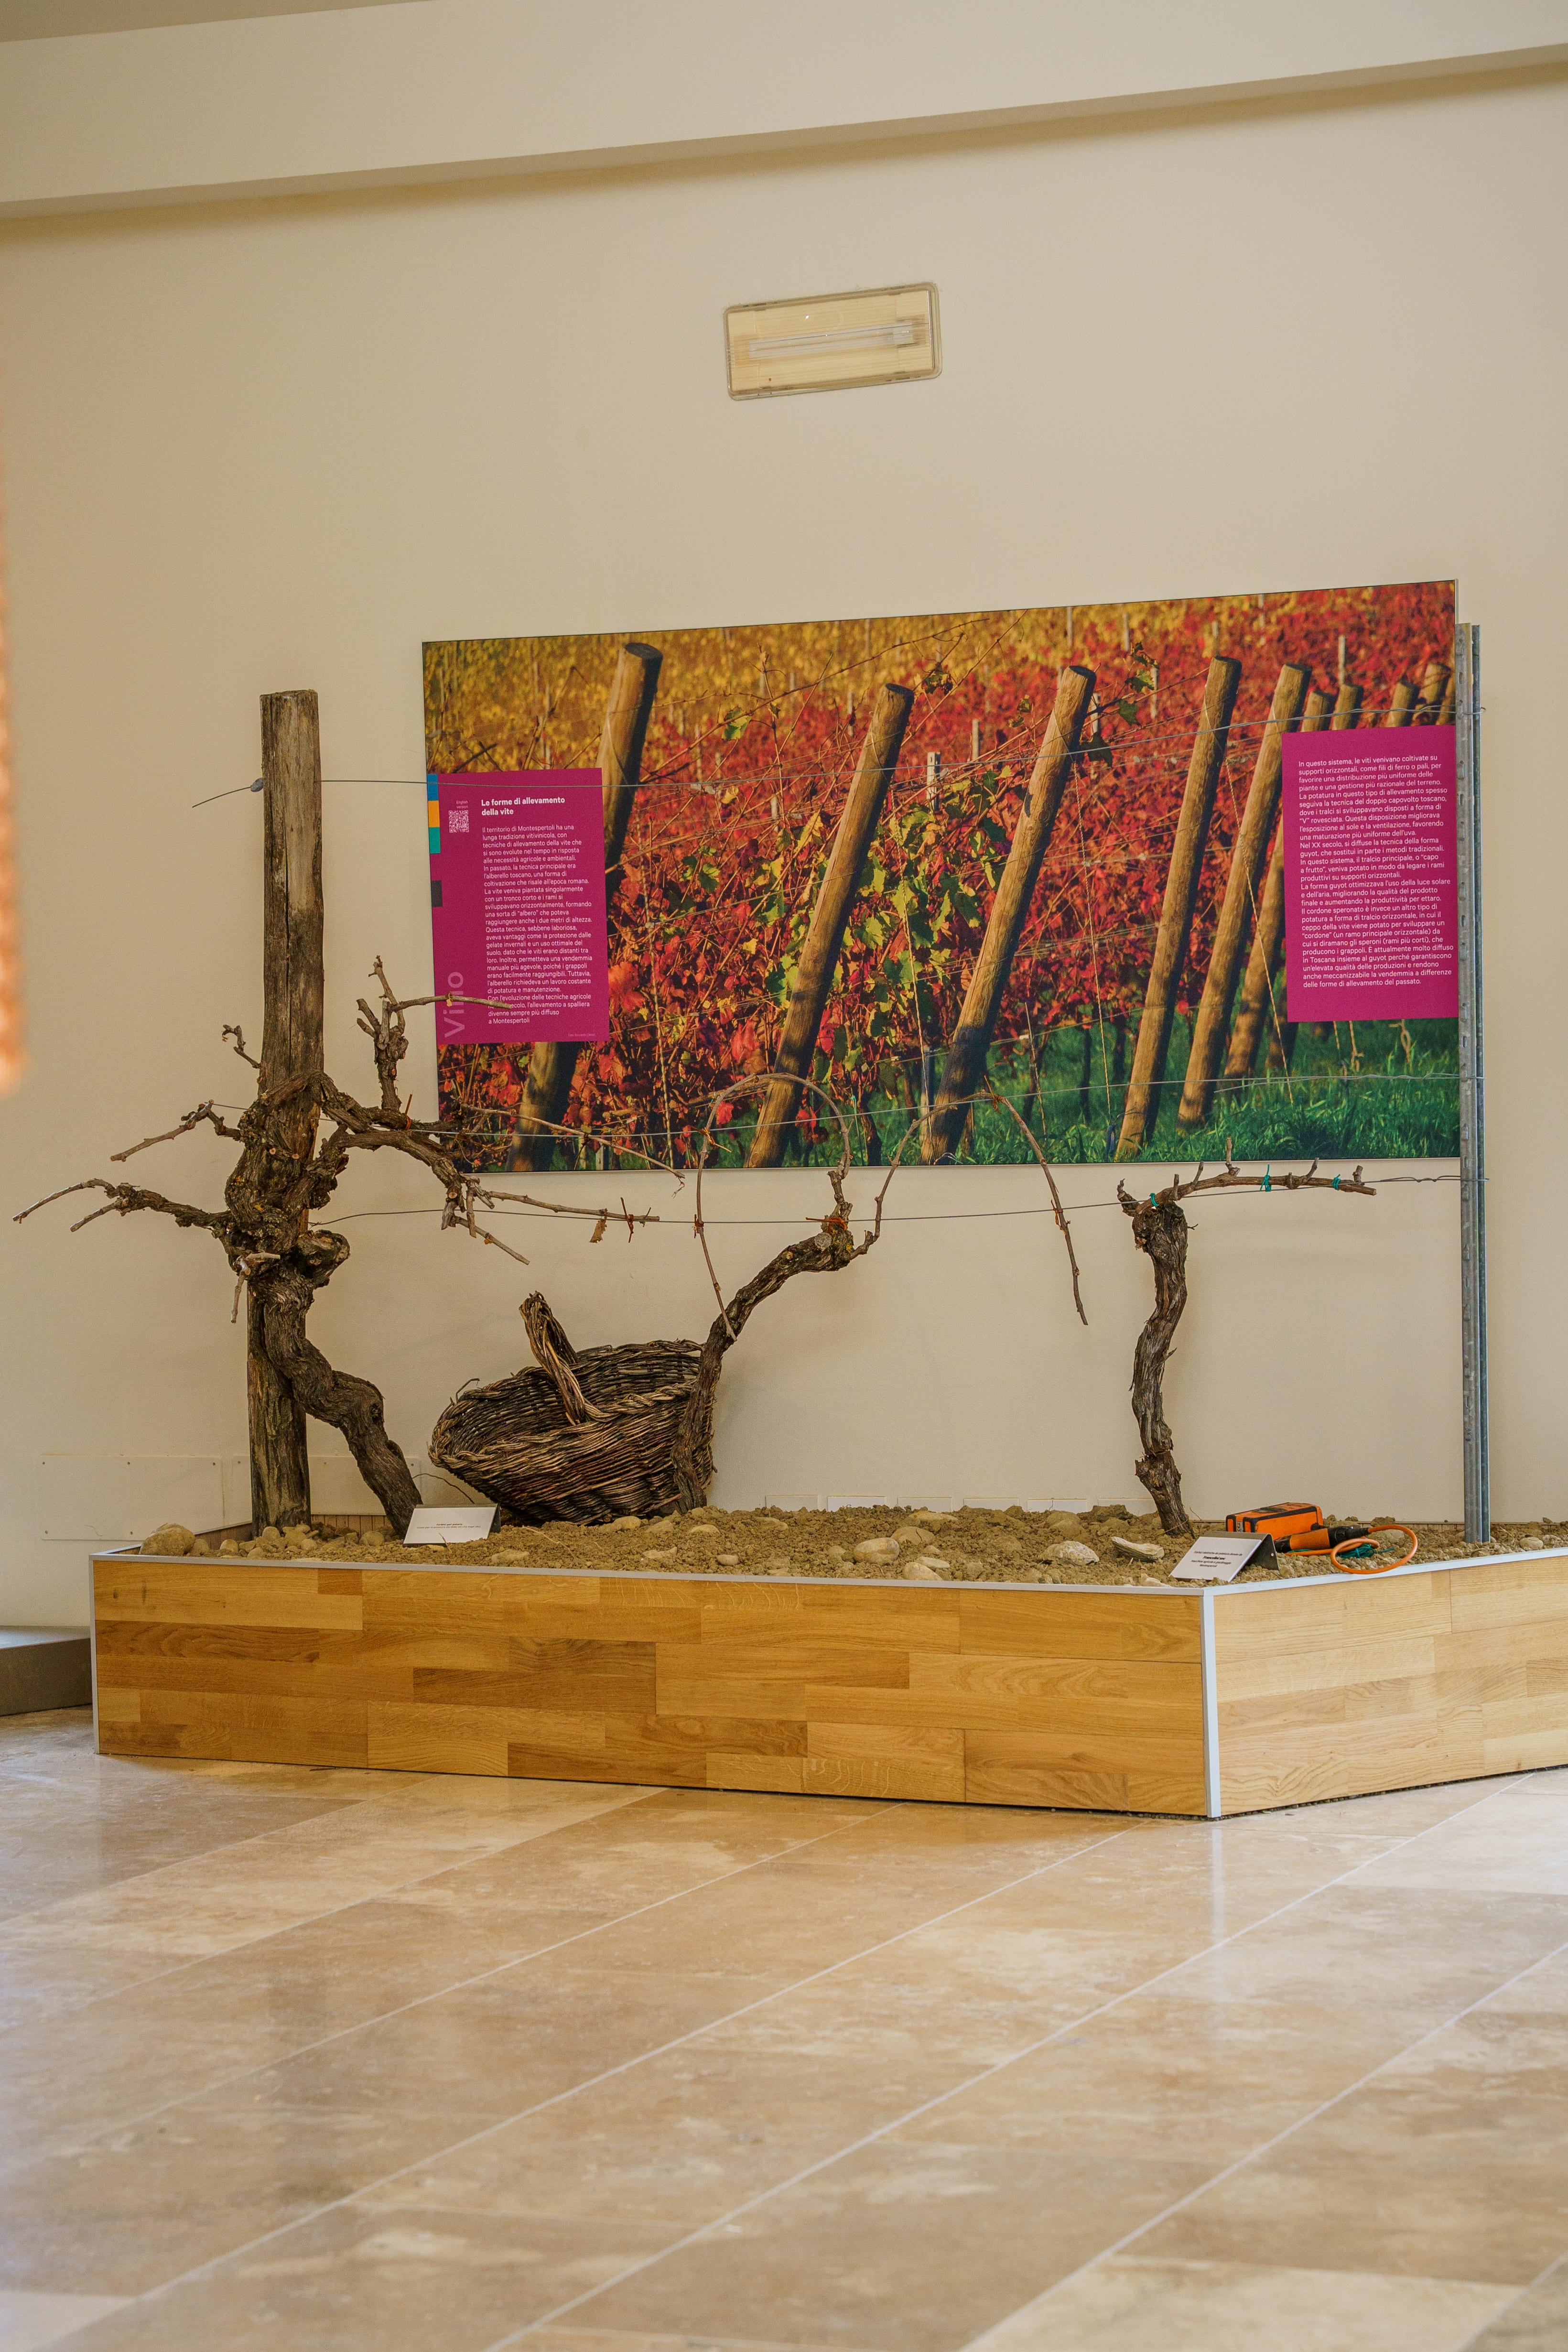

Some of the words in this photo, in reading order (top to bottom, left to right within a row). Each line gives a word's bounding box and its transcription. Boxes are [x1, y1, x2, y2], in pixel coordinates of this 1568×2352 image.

[1300, 875, 1330, 883] produttivi
[1371, 896, 1407, 904] produttività
[1340, 947, 1366, 955] grappoli.
